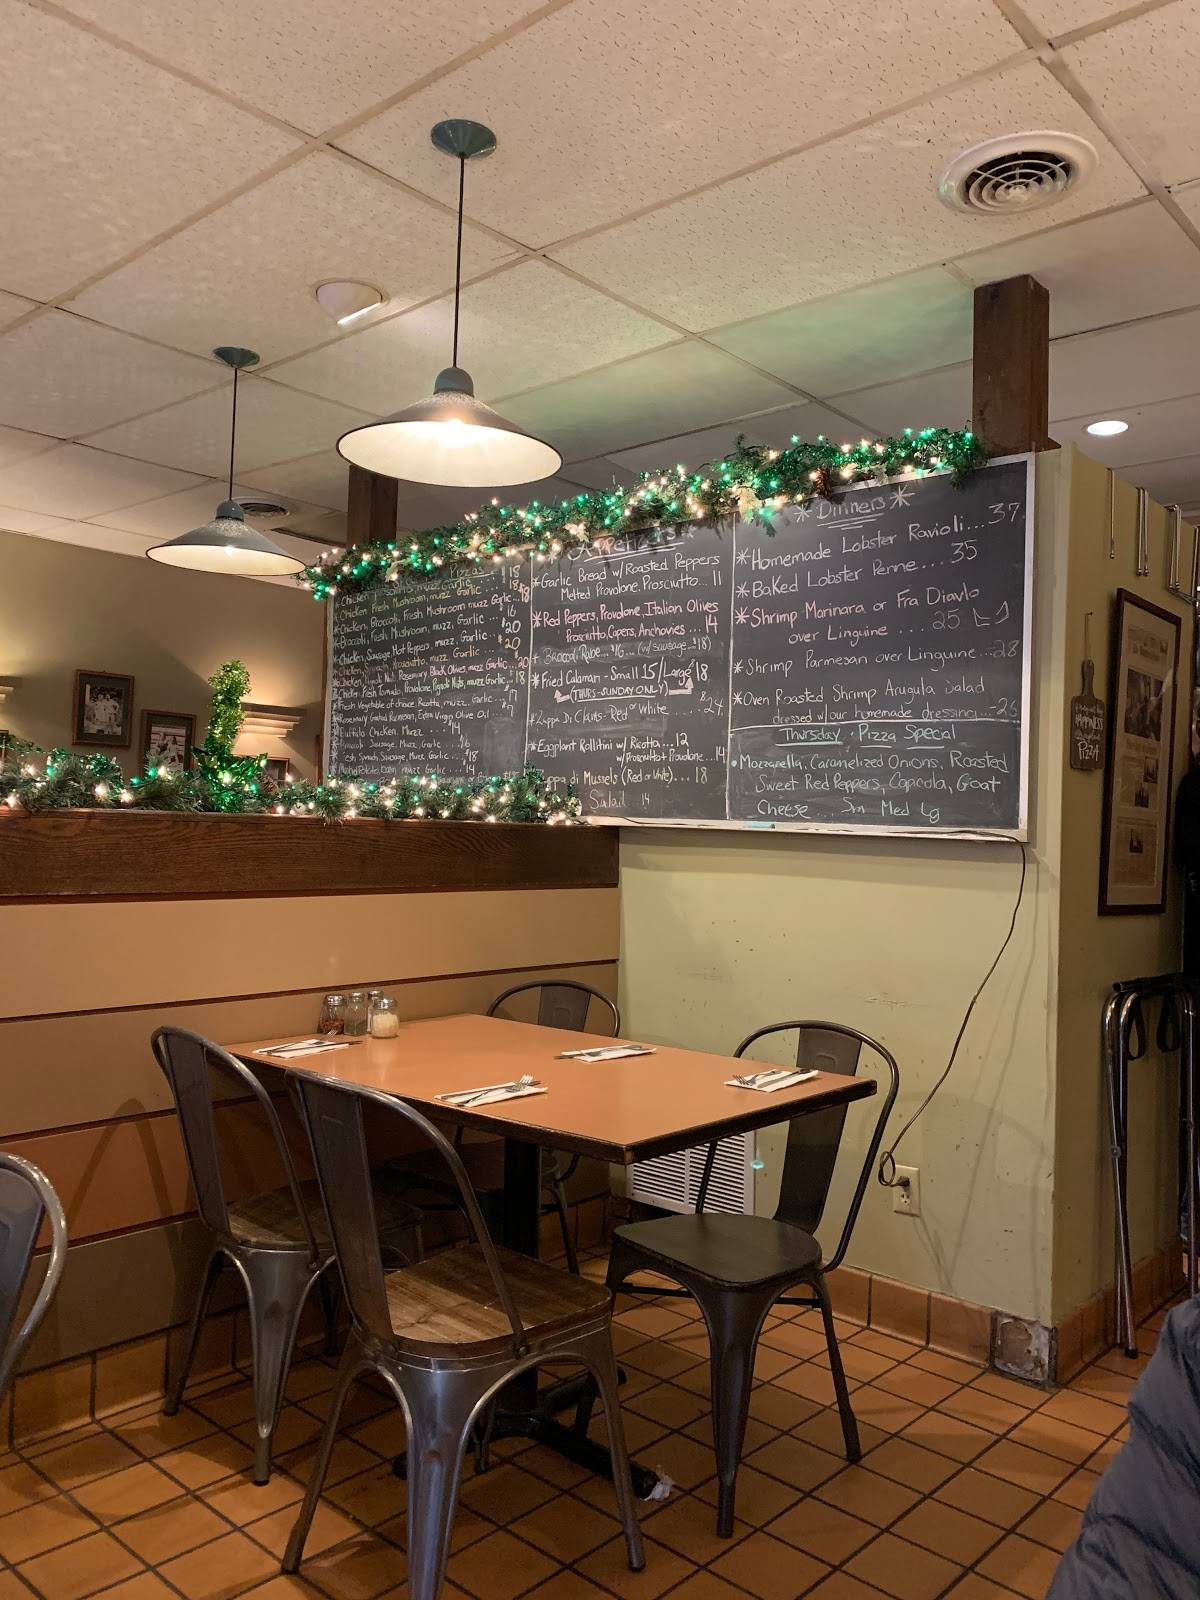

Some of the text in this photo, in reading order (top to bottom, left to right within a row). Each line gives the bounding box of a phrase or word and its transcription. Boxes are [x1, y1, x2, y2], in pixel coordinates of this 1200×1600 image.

[816, 496, 886, 519] Dinners
[752, 542, 832, 571] Homemade
[843, 530, 898, 553] Lobster
[541, 571, 572, 589] Garlic
[578, 567, 607, 583] Bread
[674, 552, 720, 571] Peppers
[808, 565, 863, 587] Lobster
[952, 540, 978, 564] 35
[561, 586, 591, 601] Melted
[713, 569, 722, 586] 11
[543, 610, 561, 627] Red
[644, 599, 683, 616] Italian
[686, 598, 719, 613] Olives
[751, 607, 798, 628] Shrimp
[805, 600, 865, 620] Marinara
[873, 601, 887, 611] or
[897, 588, 919, 608] Fra
[638, 622, 686, 637] Anchovies
[705, 614, 718, 634] 14
[788, 608, 961, 647] over Linguine 25
[746, 658, 793, 677] Shrimp
[806, 649, 868, 668] Parmesan
[875, 651, 903, 664] over
[541, 669, 563, 689] Fried
[743, 675, 985, 706] Oven Roasted Shrimp Arugula Salad
[609, 704, 628, 723] Red
[638, 700, 669, 716] White
[772, 708, 813, 724] dressed
[855, 703, 913, 720] homemade
[537, 738, 577, 758] Eggplant
[675, 732, 690, 747] 12
[778, 723, 956, 743] Thursday Pizza Special
[811, 753, 884, 770] Caramelized
[950, 750, 1010, 773] Roasted
[569, 770, 579, 785] di
[583, 767, 618, 785] Mussels
[695, 767, 708, 785] 18
[756, 774, 799, 793] Sweet
[805, 772, 830, 790] Red
[957, 772, 1001, 793] Goat
[757, 800, 811, 819] Cheese
[881, 799, 910, 817] Med
[921, 802, 940, 824] Lg
